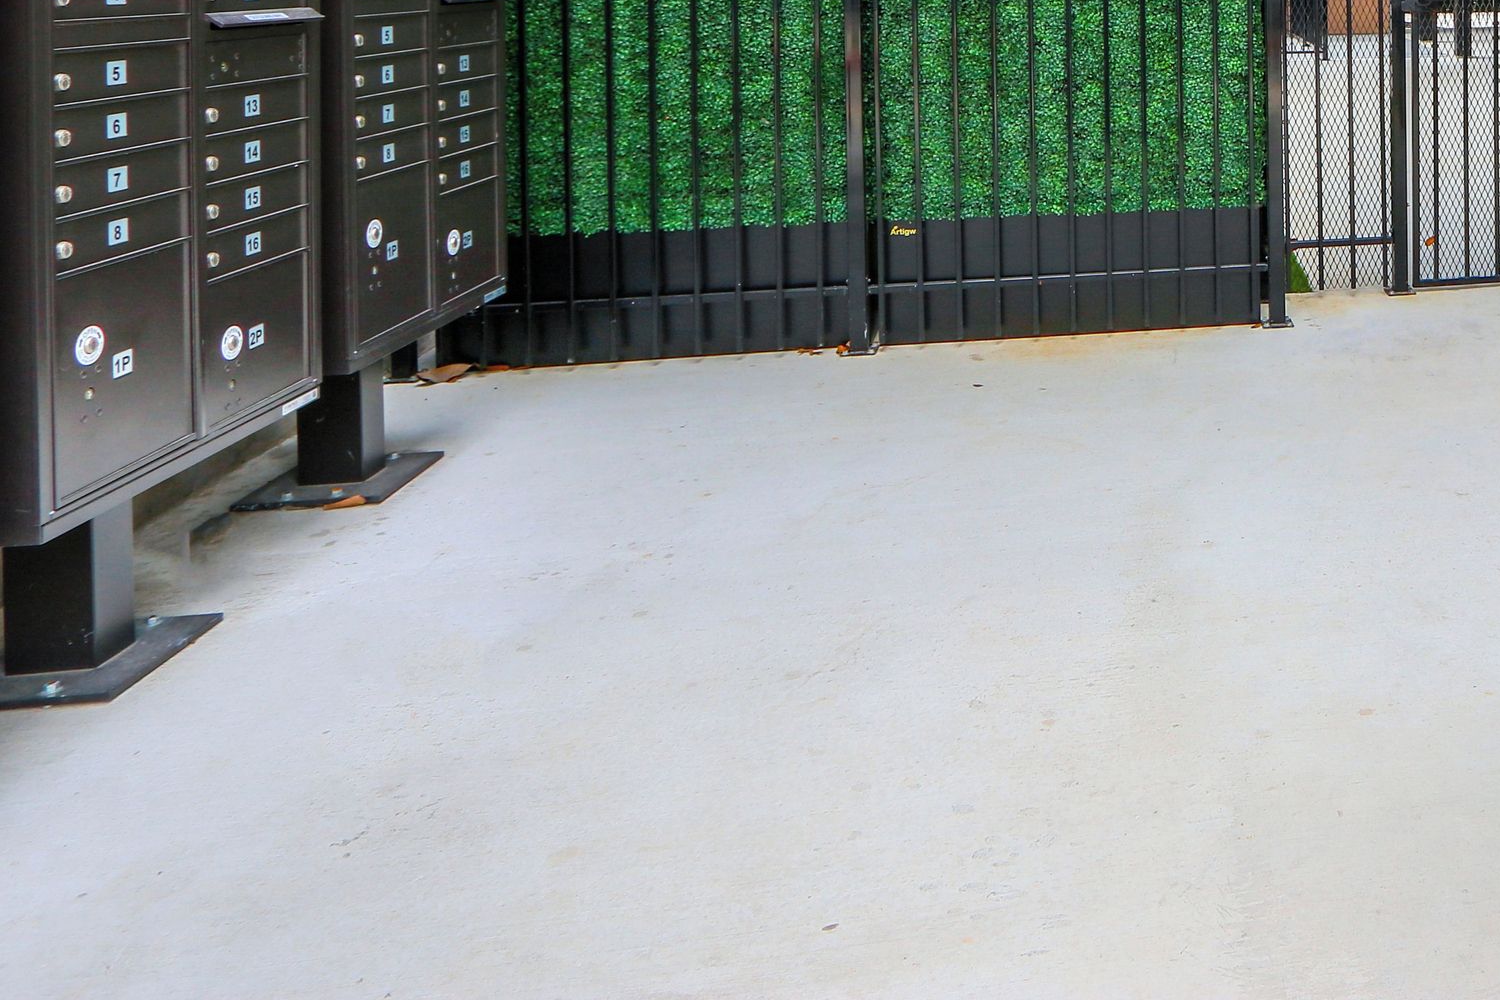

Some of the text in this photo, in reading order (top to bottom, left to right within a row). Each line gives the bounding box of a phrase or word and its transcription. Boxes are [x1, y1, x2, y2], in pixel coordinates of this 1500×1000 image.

[112, 66, 120, 81] 5
[246, 99, 258, 113] 13
[113, 119, 120, 134] 6
[247, 146, 258, 159] 14
[113, 172, 121, 187] 7
[247, 191, 258, 206] 15
[114, 225, 122, 240] 8
[890, 225, 917, 236] Artigw
[248, 237, 259, 251] 16
[250, 329, 262, 346] 2P
[114, 356, 131, 375] 1P
